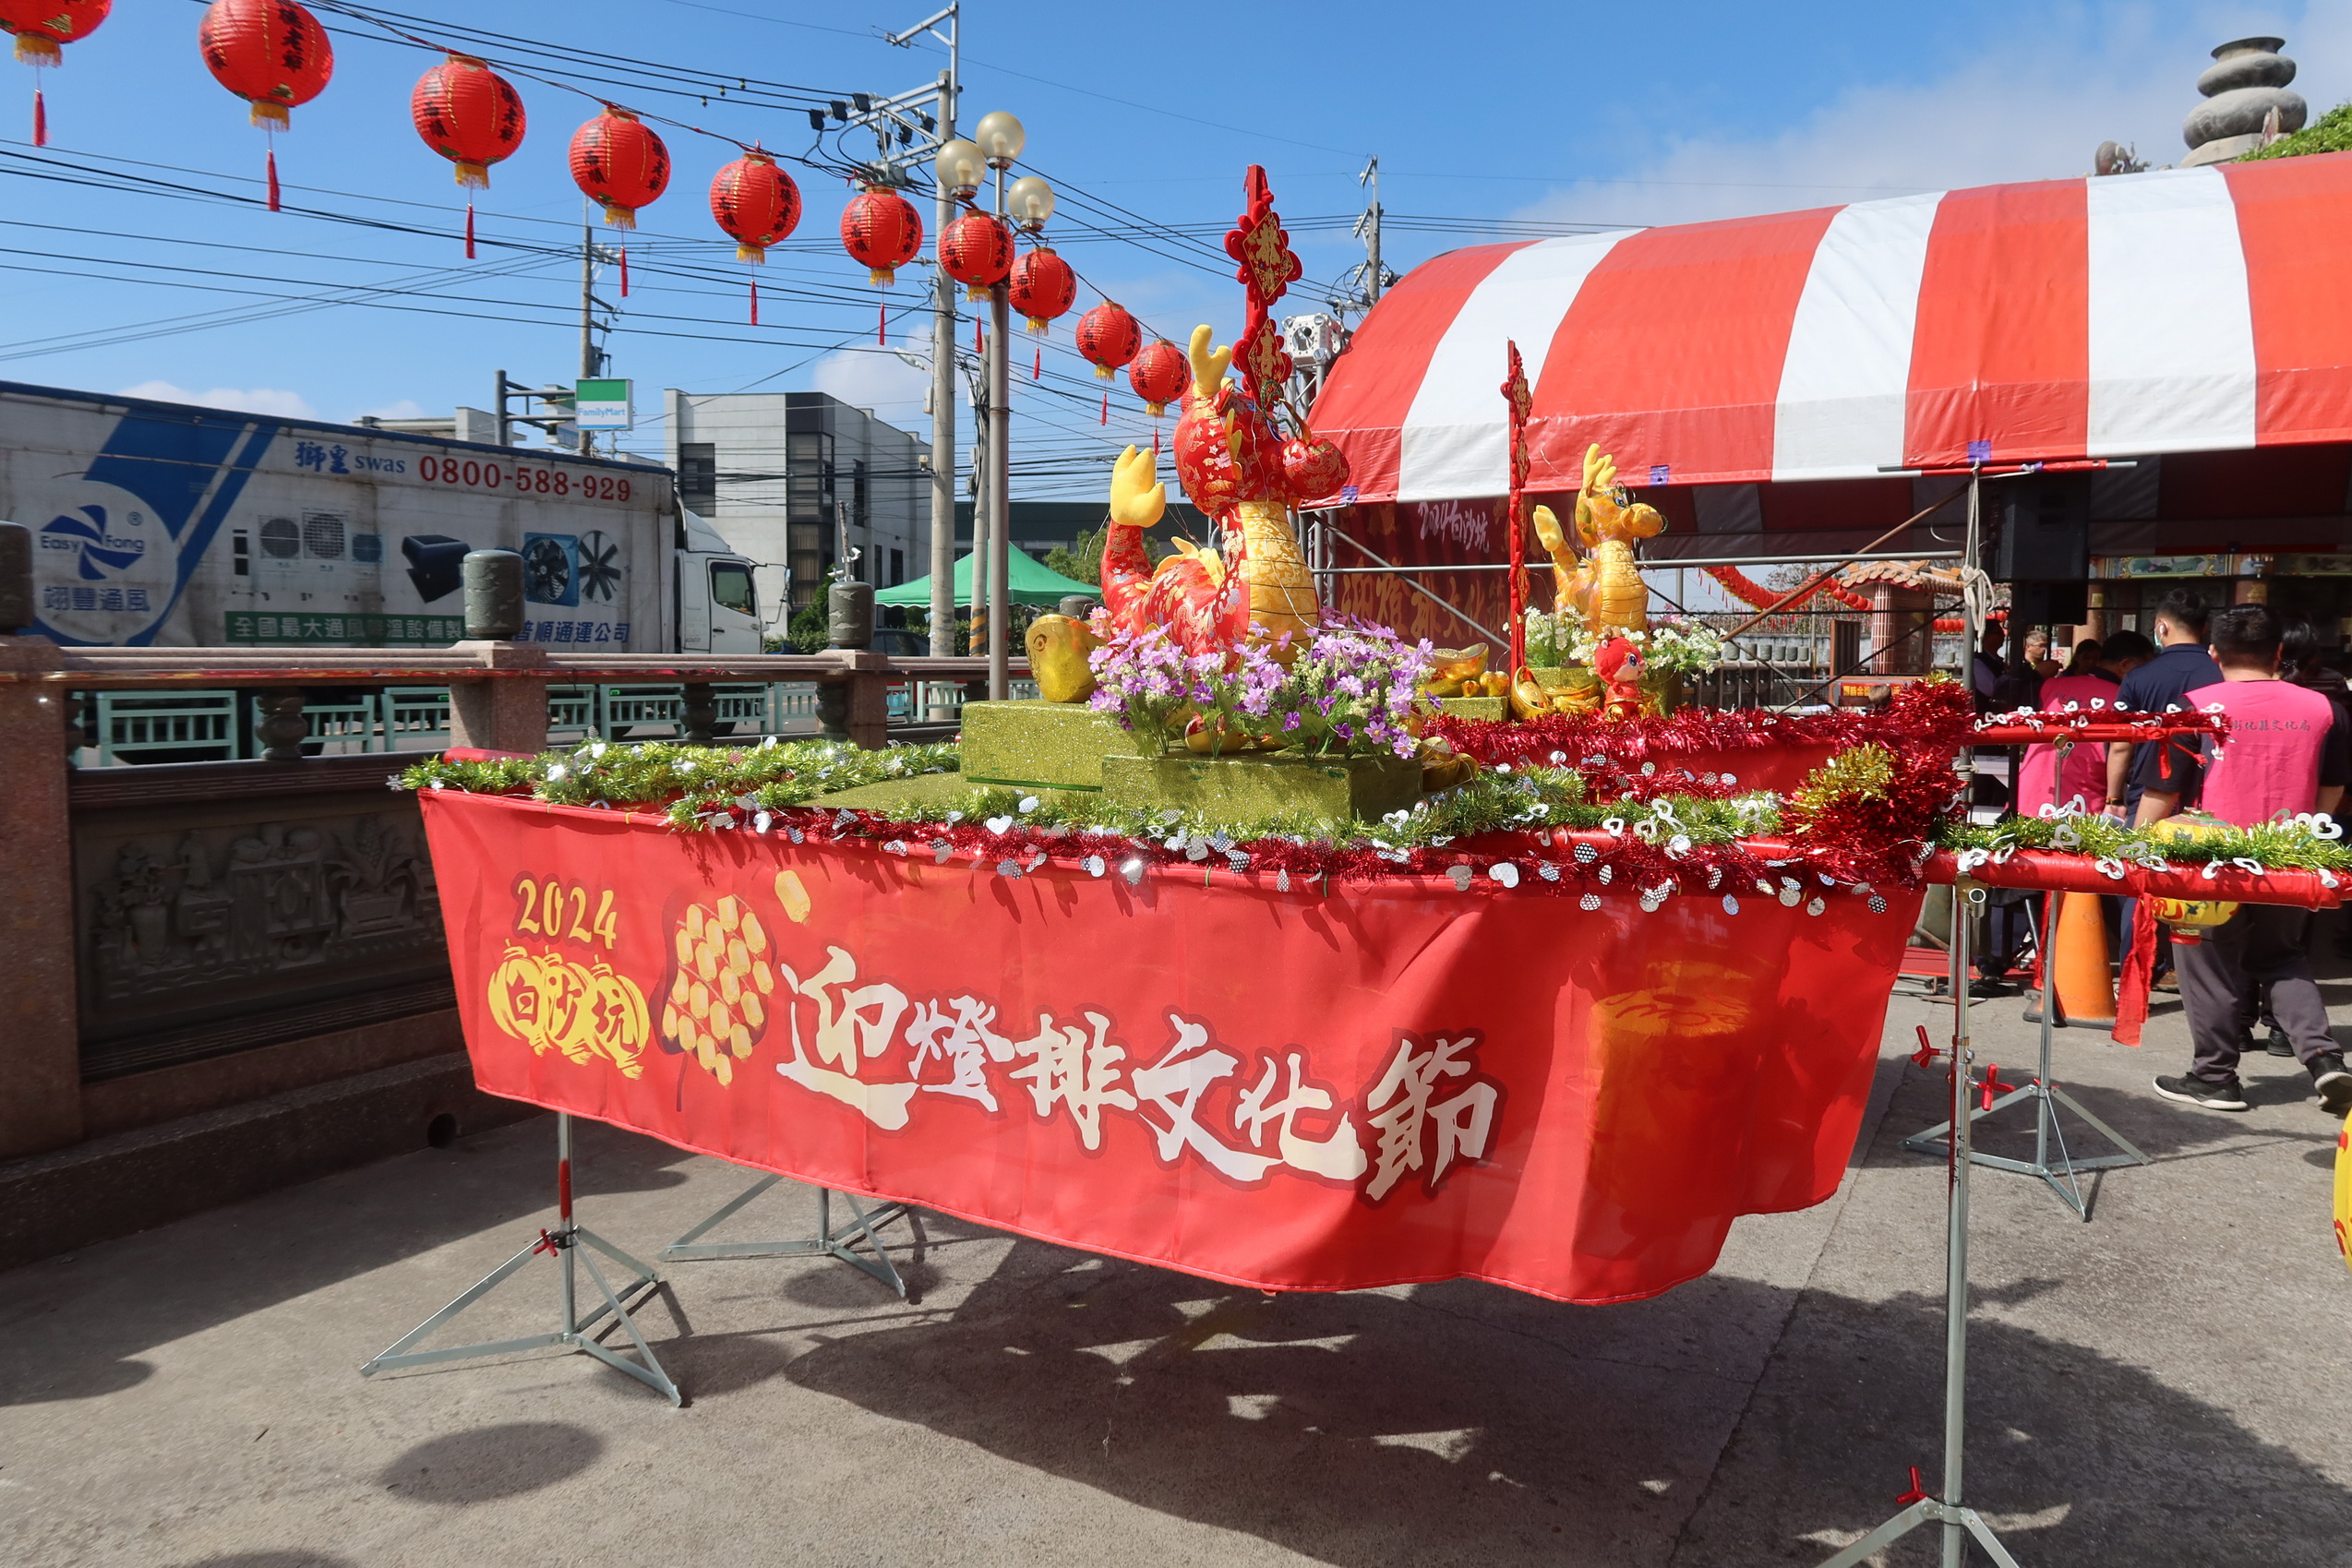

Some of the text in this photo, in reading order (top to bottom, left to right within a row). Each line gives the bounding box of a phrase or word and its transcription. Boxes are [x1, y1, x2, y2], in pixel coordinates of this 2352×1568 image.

[577, 407, 626, 418] FamilyMart
[354, 455, 405, 473] swas
[419, 456, 630, 502] 0800-588-929
[41, 535, 80, 553] Easy
[516, 878, 618, 951] 2024
[776, 945, 1497, 1200] 迎燈排文化節
